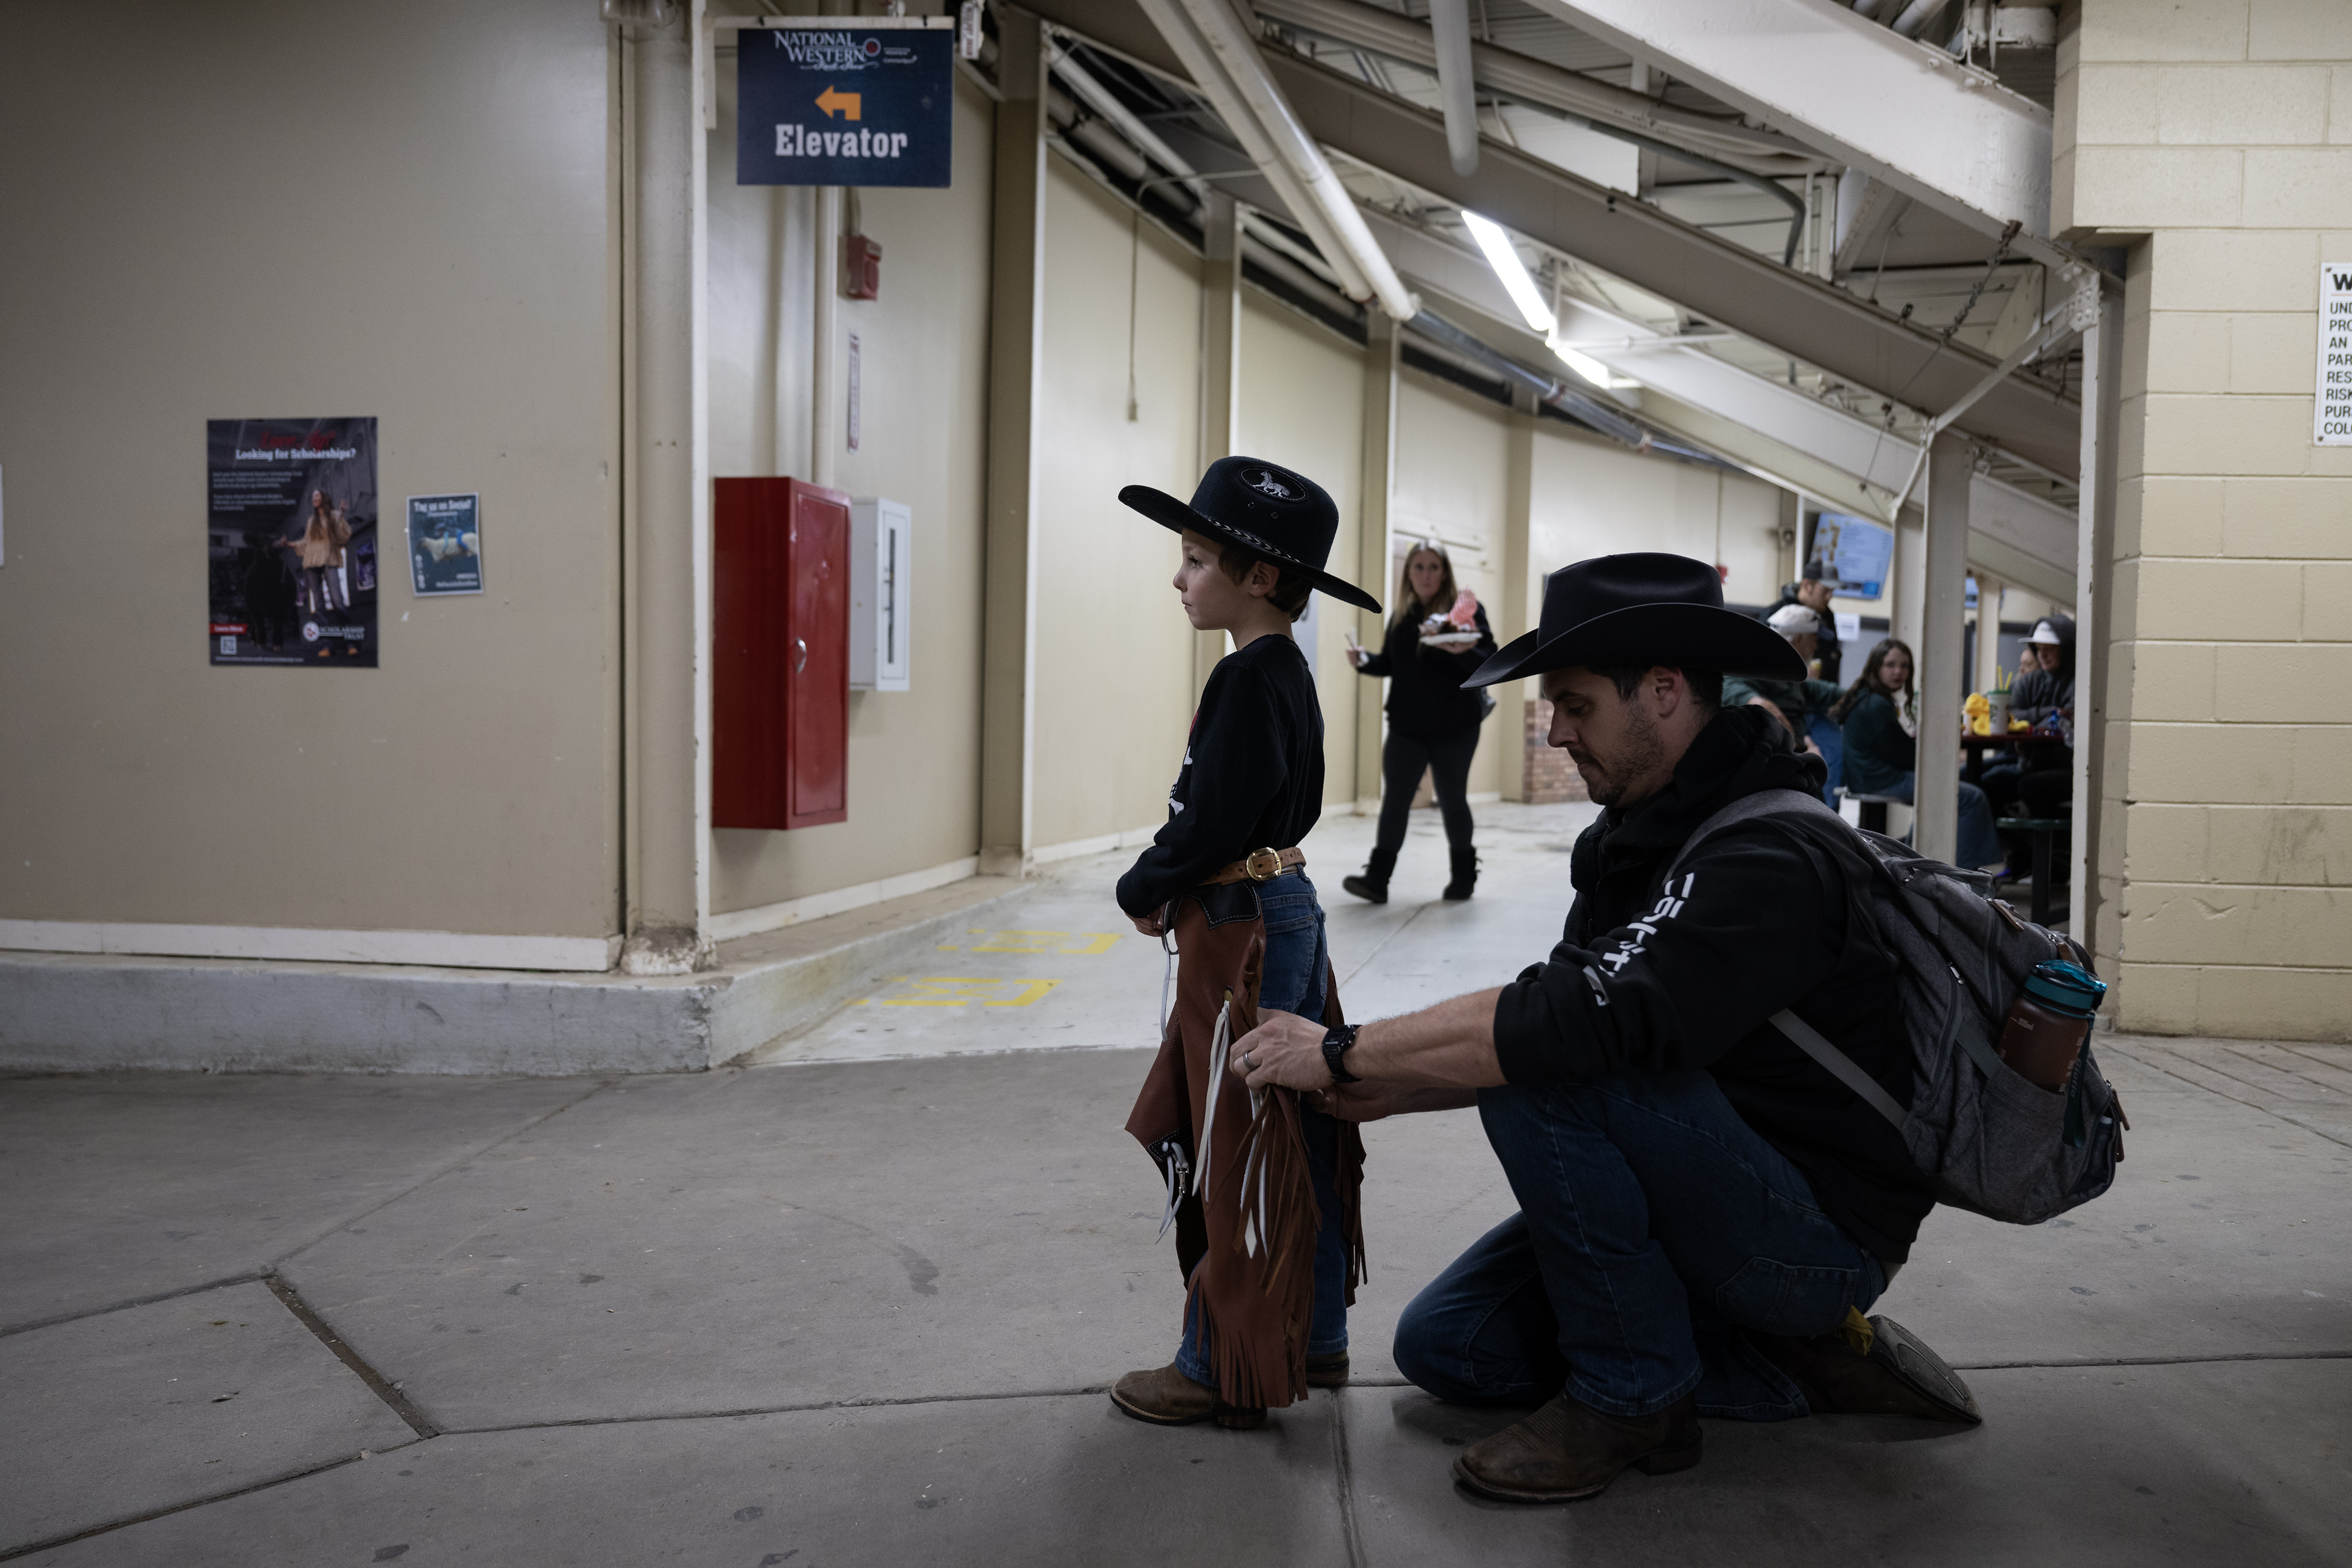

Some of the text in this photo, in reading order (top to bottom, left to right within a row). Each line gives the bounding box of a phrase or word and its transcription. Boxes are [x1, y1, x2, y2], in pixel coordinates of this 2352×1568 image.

[773, 30, 856, 49] NATIONAL
[787, 46, 866, 63] WESTERN
[775, 124, 908, 157] Elevator
[2329, 337, 2347, 348] AN
[236, 447, 356, 462] Looking for Scholarships?
